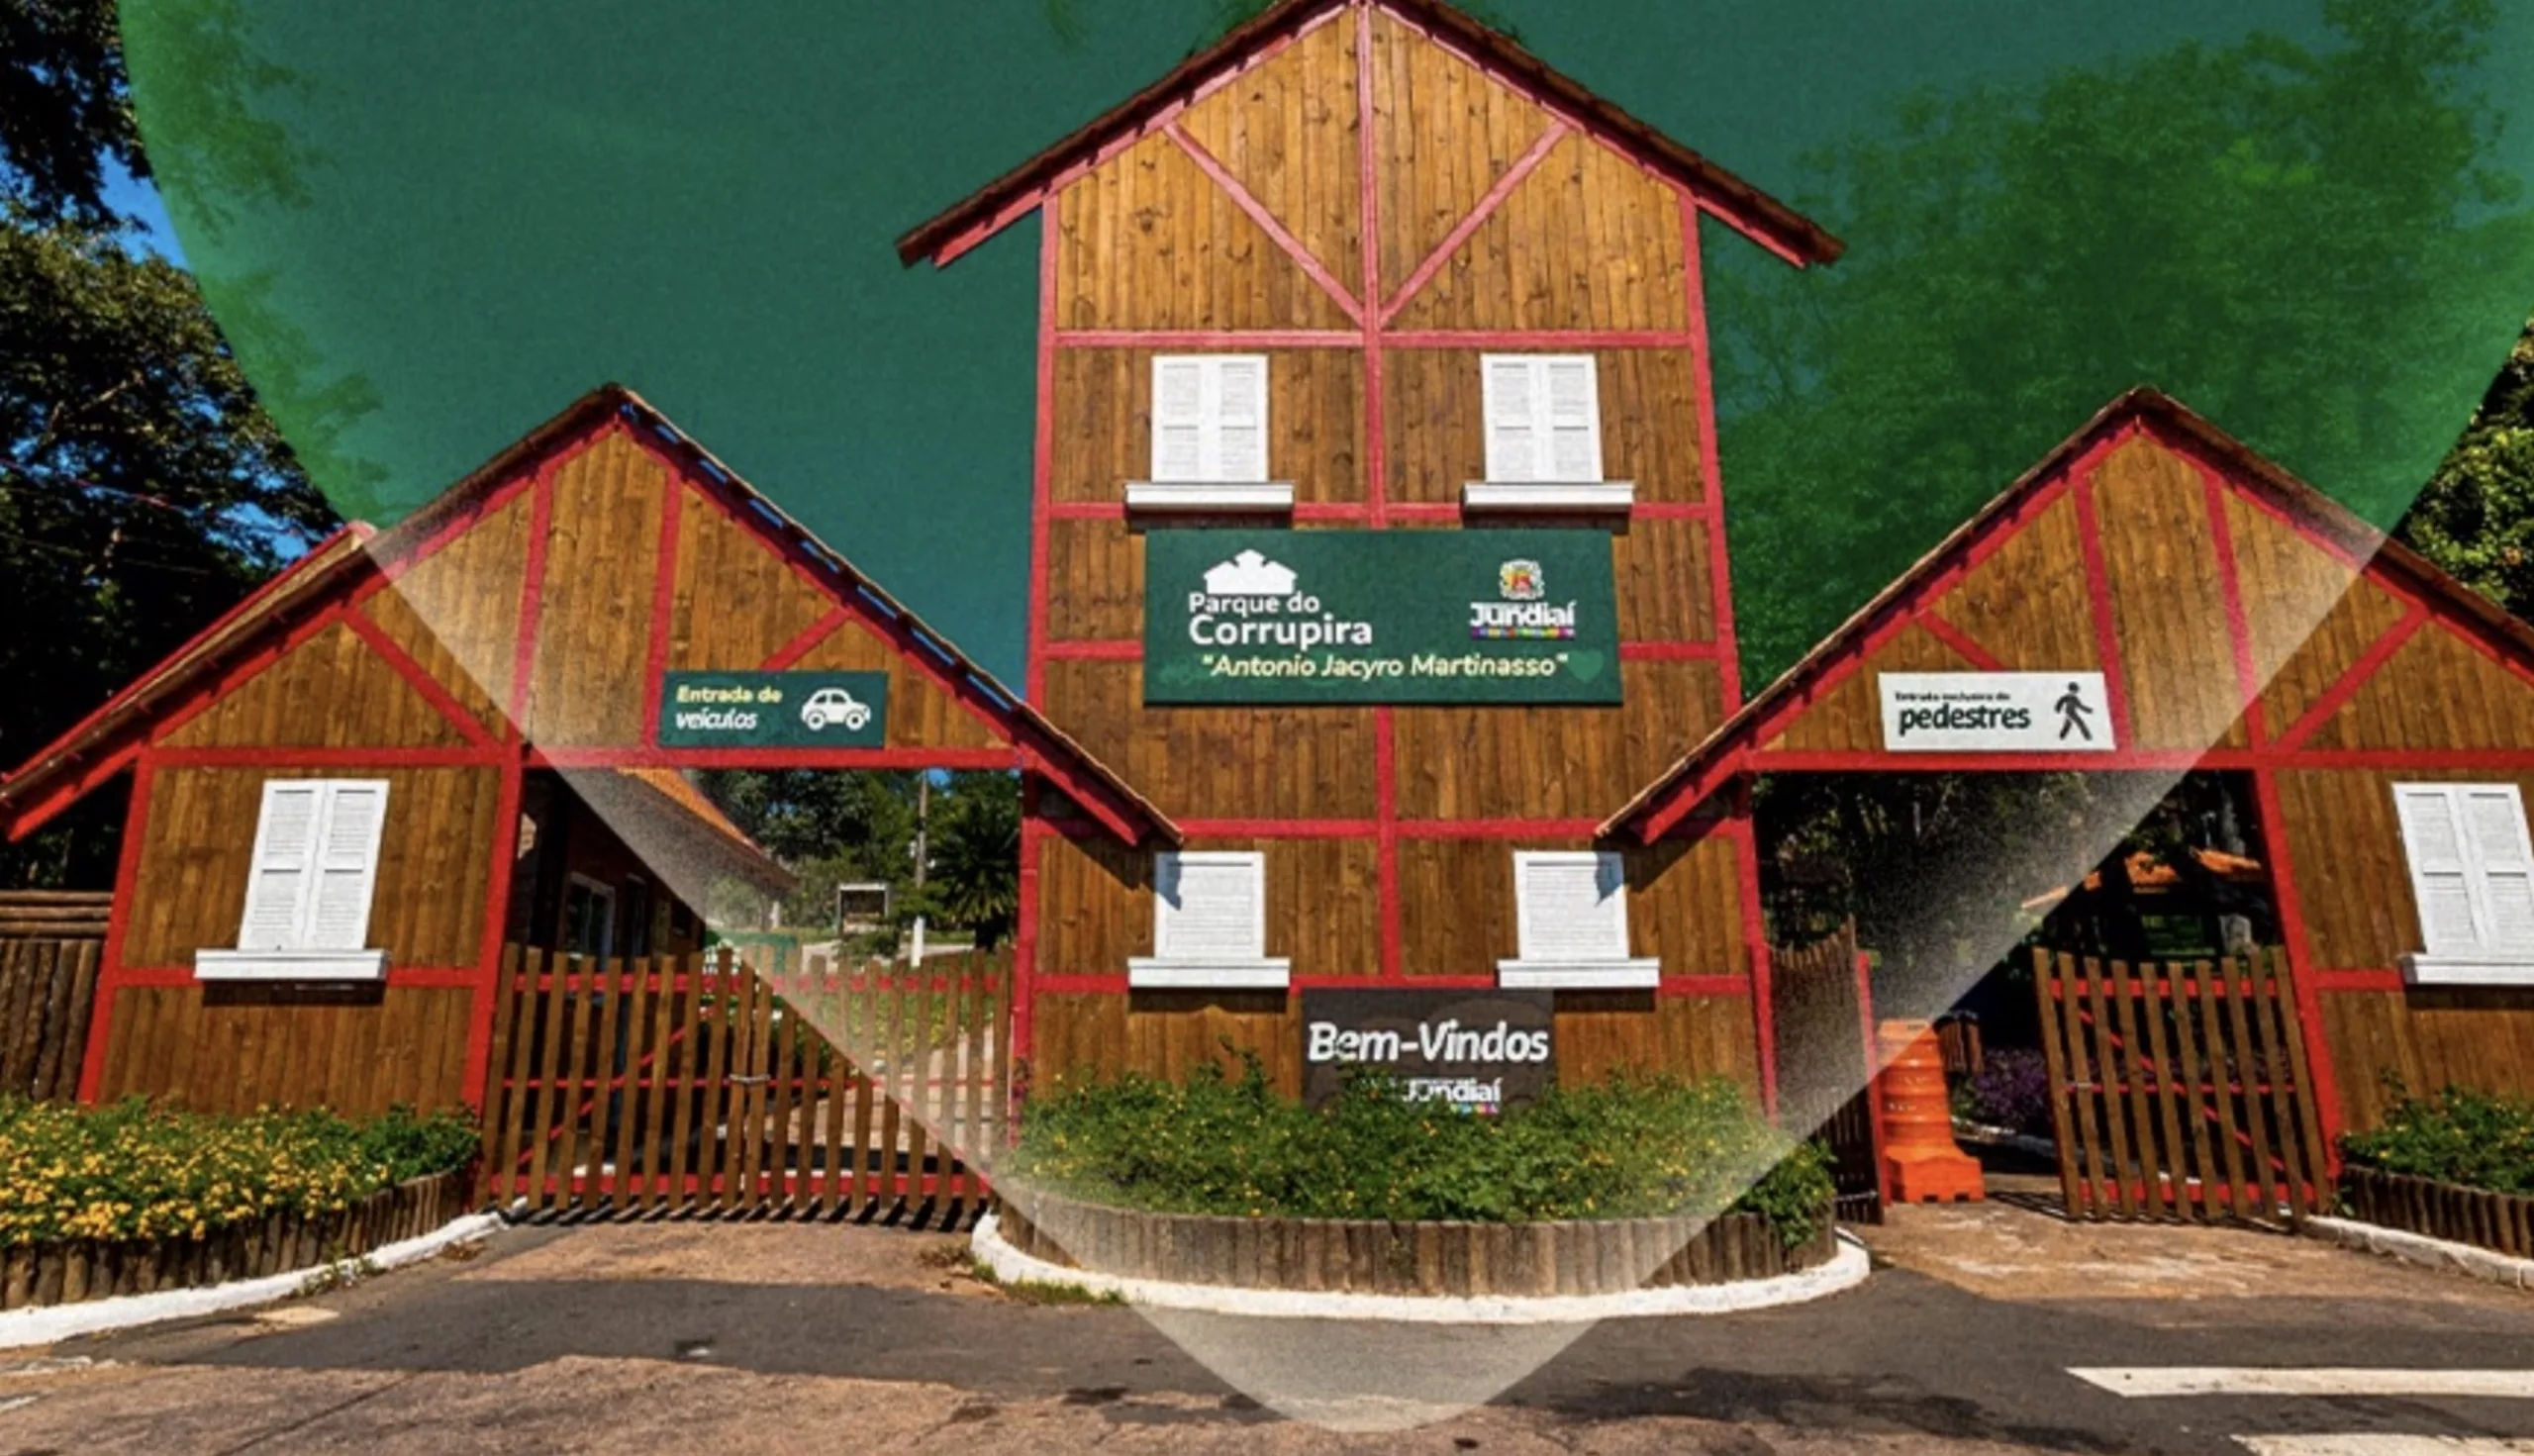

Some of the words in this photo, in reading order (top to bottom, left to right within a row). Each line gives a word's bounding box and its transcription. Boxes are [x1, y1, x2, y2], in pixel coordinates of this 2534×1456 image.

[1190, 593, 1279, 618] Parque
[1287, 591, 1319, 613] do
[1470, 600, 1577, 627] Jundiaí
[1189, 614, 1373, 649] Corrupira
[1320, 654, 1404, 681] Jacyro
[676, 685, 753, 703] Entrada
[757, 686, 783, 703] de
[1899, 703, 2031, 736] pedestres
[1308, 1019, 1549, 1062] Bem-Vindos
